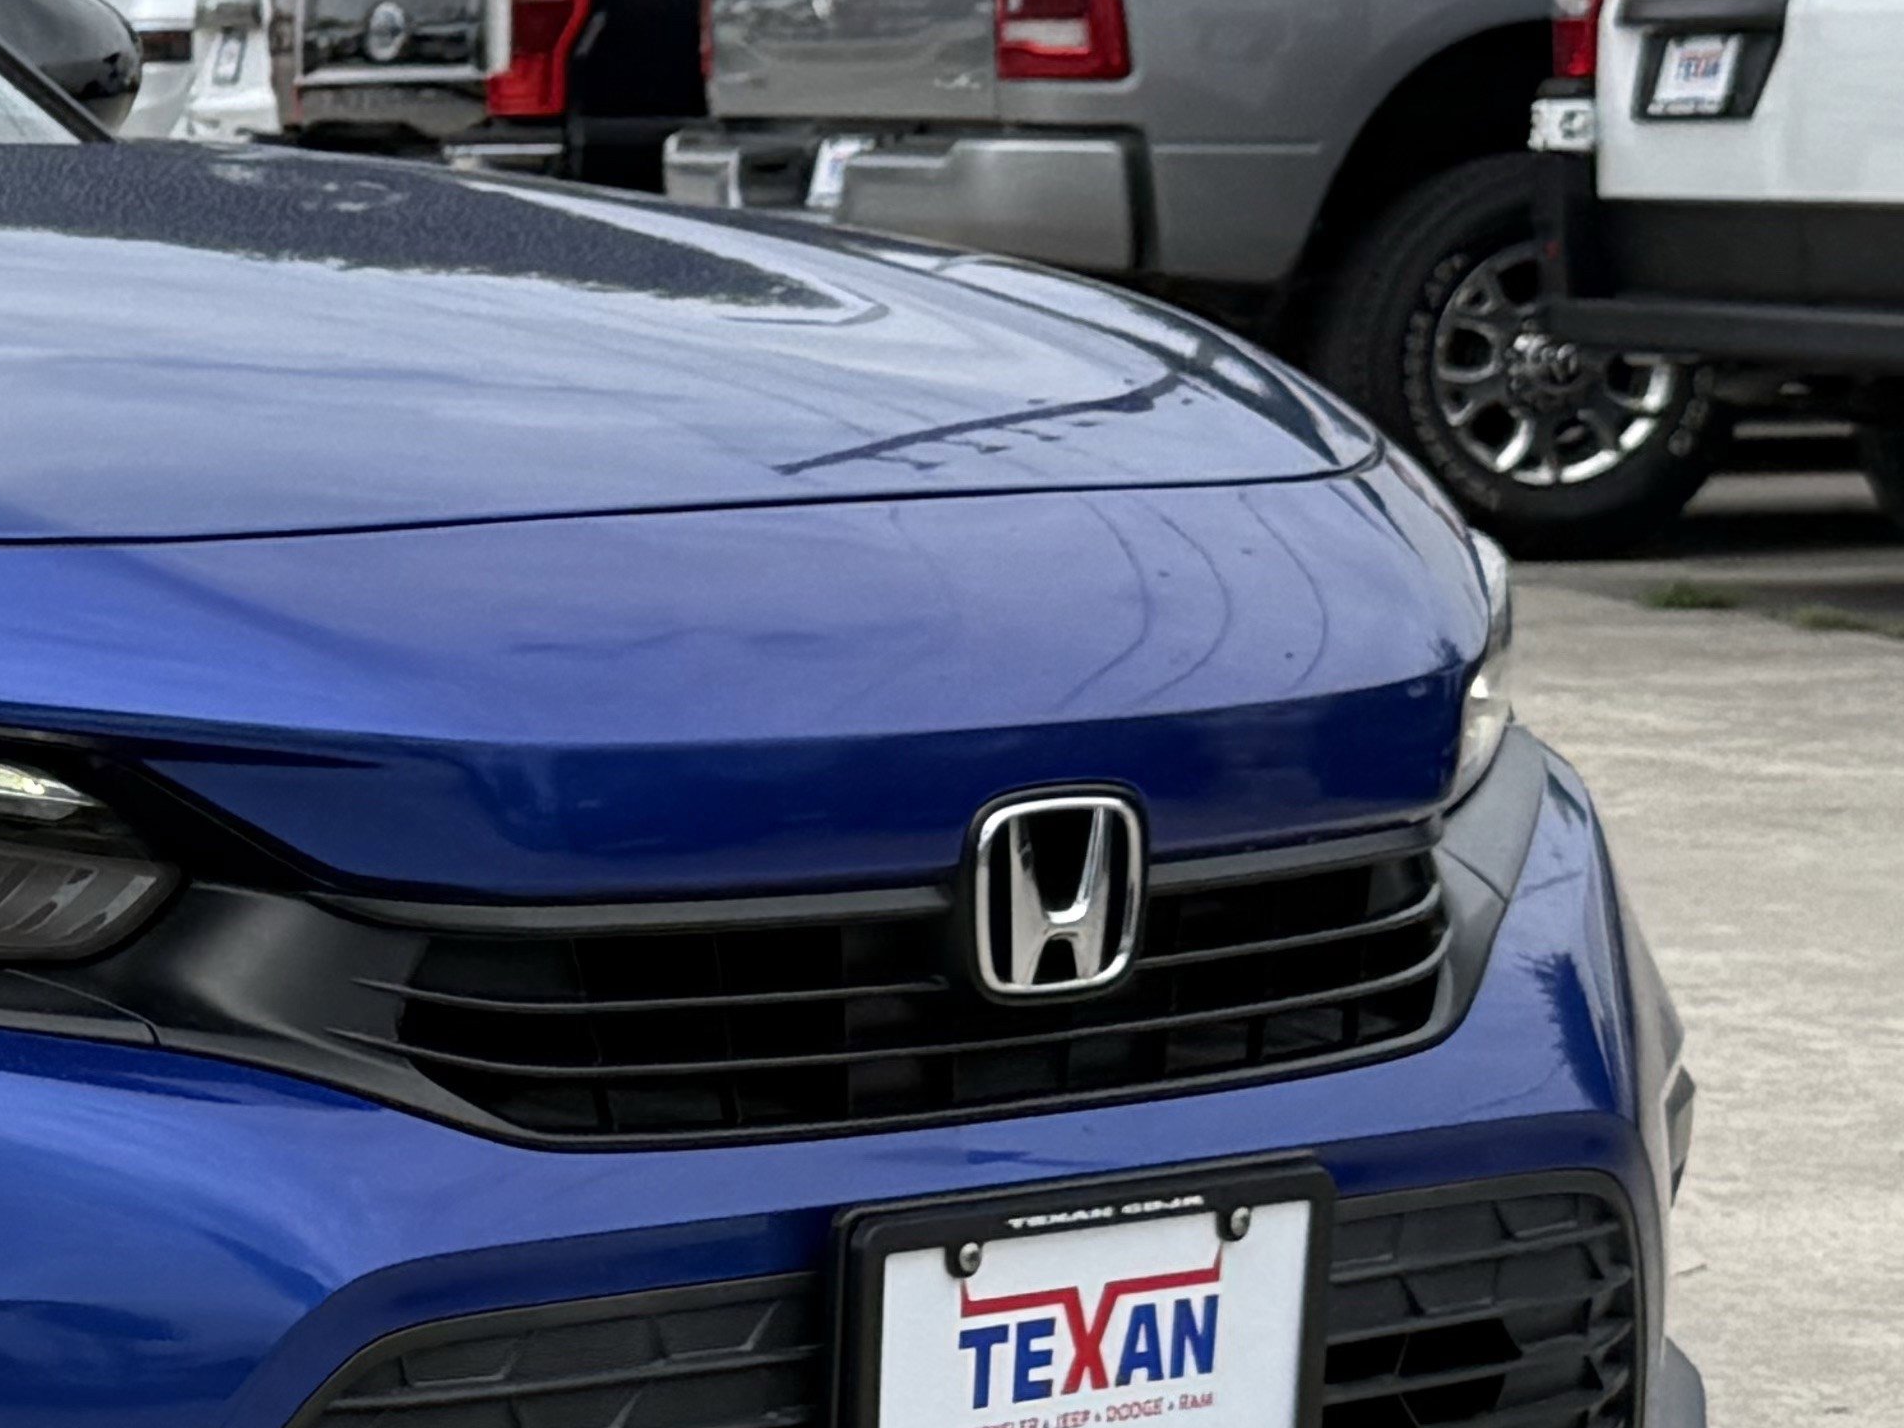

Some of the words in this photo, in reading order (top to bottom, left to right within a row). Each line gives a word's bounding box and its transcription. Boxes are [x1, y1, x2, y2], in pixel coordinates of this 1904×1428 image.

[1008, 1206, 1114, 1229] TEXAN
[958, 1267, 1221, 1409] TEXAN
[1106, 1397, 1164, 1423] DODGE
[1178, 1391, 1214, 1410] RAM
